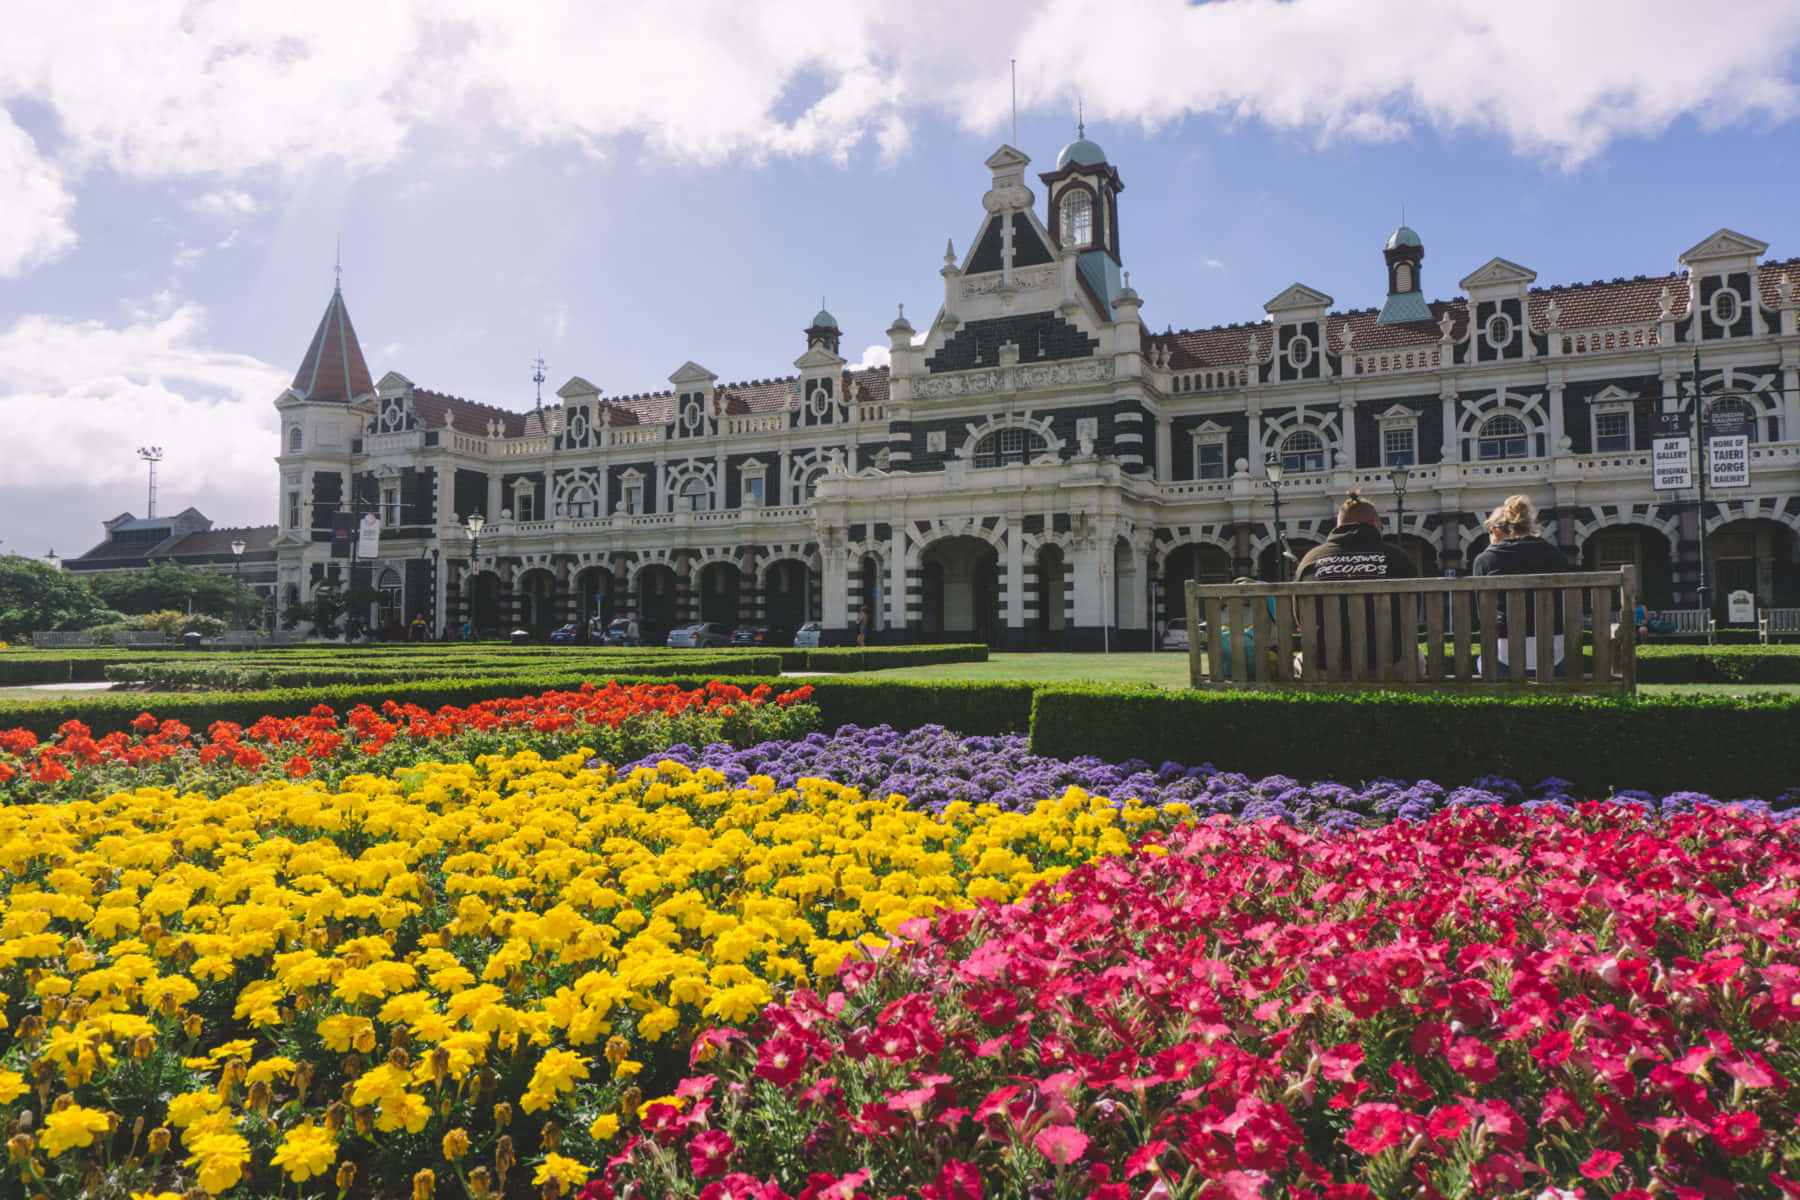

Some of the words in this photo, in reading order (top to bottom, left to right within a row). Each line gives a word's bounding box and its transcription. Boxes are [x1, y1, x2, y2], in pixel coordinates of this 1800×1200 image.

[1664, 441, 1679, 450] ART
[1735, 439, 1744, 447] OF
[1656, 451, 1687, 460] GALLERY
[1714, 450, 1744, 460] TAIERI
[1656, 467, 1688, 476] ORIGINAL
[1714, 462, 1745, 473] GORGE
[1662, 476, 1684, 485] GIFTS
[1714, 475, 1745, 483] RAILWAY
[1315, 564, 1388, 577] RECORDS
